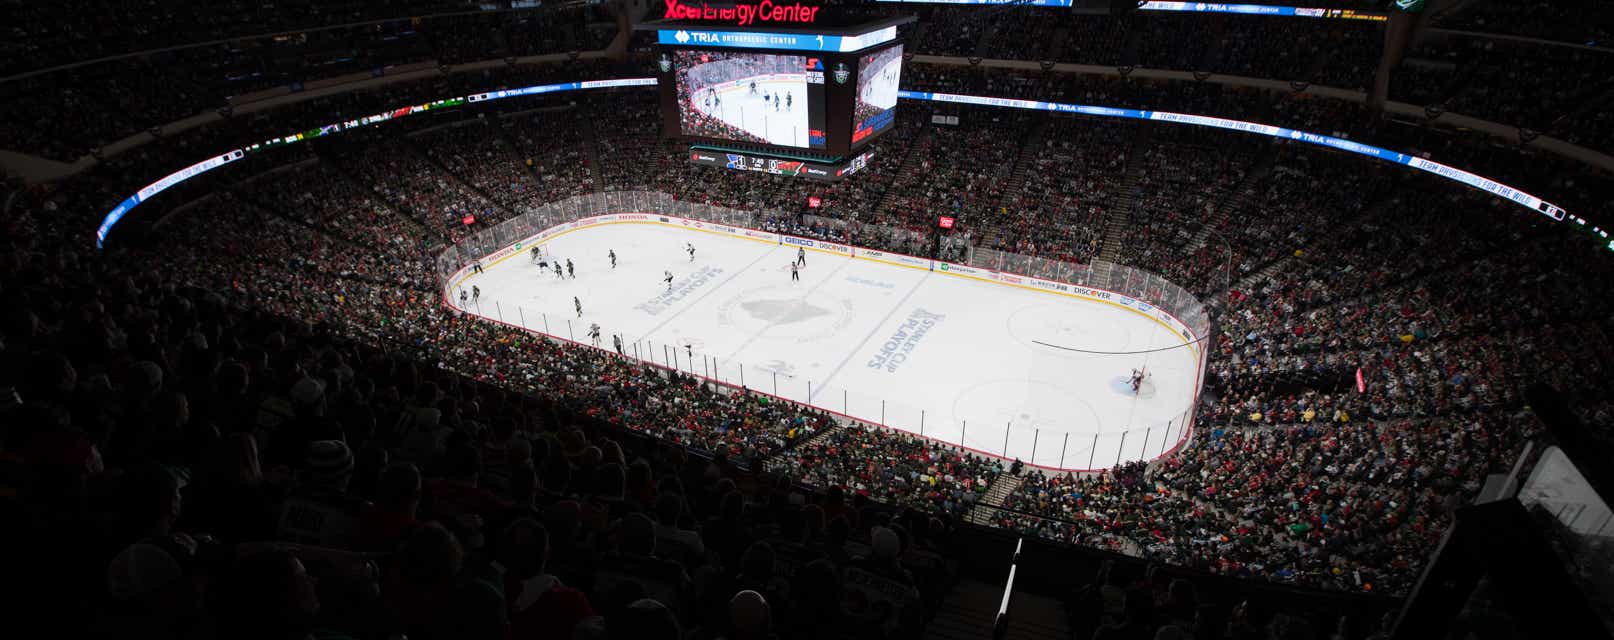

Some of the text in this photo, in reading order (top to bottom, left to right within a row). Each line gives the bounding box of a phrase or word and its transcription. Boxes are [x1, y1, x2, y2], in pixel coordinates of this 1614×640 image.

[664, 0, 701, 19] Xcel
[758, 1, 819, 22] Center
[691, 32, 720, 43] TRIA
[769, 36, 797, 45] CENTER
[1057, 104, 1076, 112] TRIA
[1160, 113, 1178, 121] TEAM
[1220, 120, 1234, 129] FOR
[1235, 122, 1249, 130] THE
[1303, 132, 1325, 143] TRIA
[1418, 160, 1438, 173] TEAM
[1481, 180, 1498, 192] FOR
[1497, 185, 1515, 197] THE
[784, 237, 814, 248] GEICO
[819, 242, 849, 253] DISCOVER
[488, 246, 515, 262] HONDA
[1074, 287, 1111, 300] DISCOVER
[867, 318, 919, 369] PLAYOFFS
[887, 319, 935, 373] STANLEY CUP
